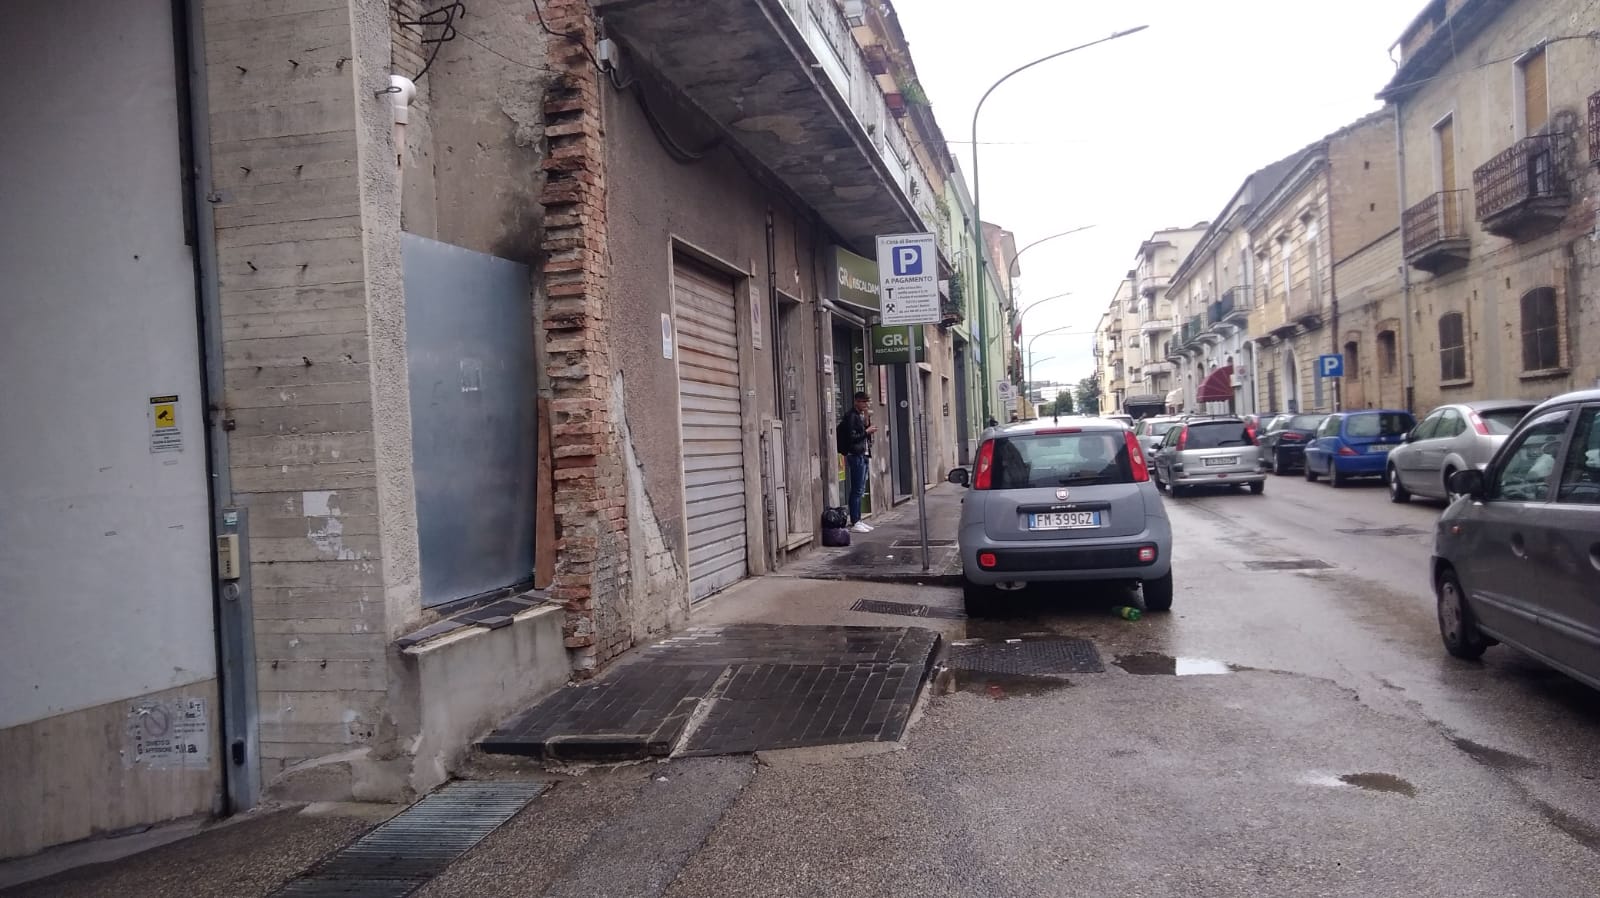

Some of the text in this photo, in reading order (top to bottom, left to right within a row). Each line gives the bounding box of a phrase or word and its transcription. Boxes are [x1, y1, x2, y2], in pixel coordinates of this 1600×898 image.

[899, 248, 918, 274] P
[891, 276, 933, 284] PAGAMENTO
[875, 346, 922, 354] RISCALDAMEO
[1324, 357, 1339, 375] P
[1037, 512, 1092, 526] FM 399GZ
